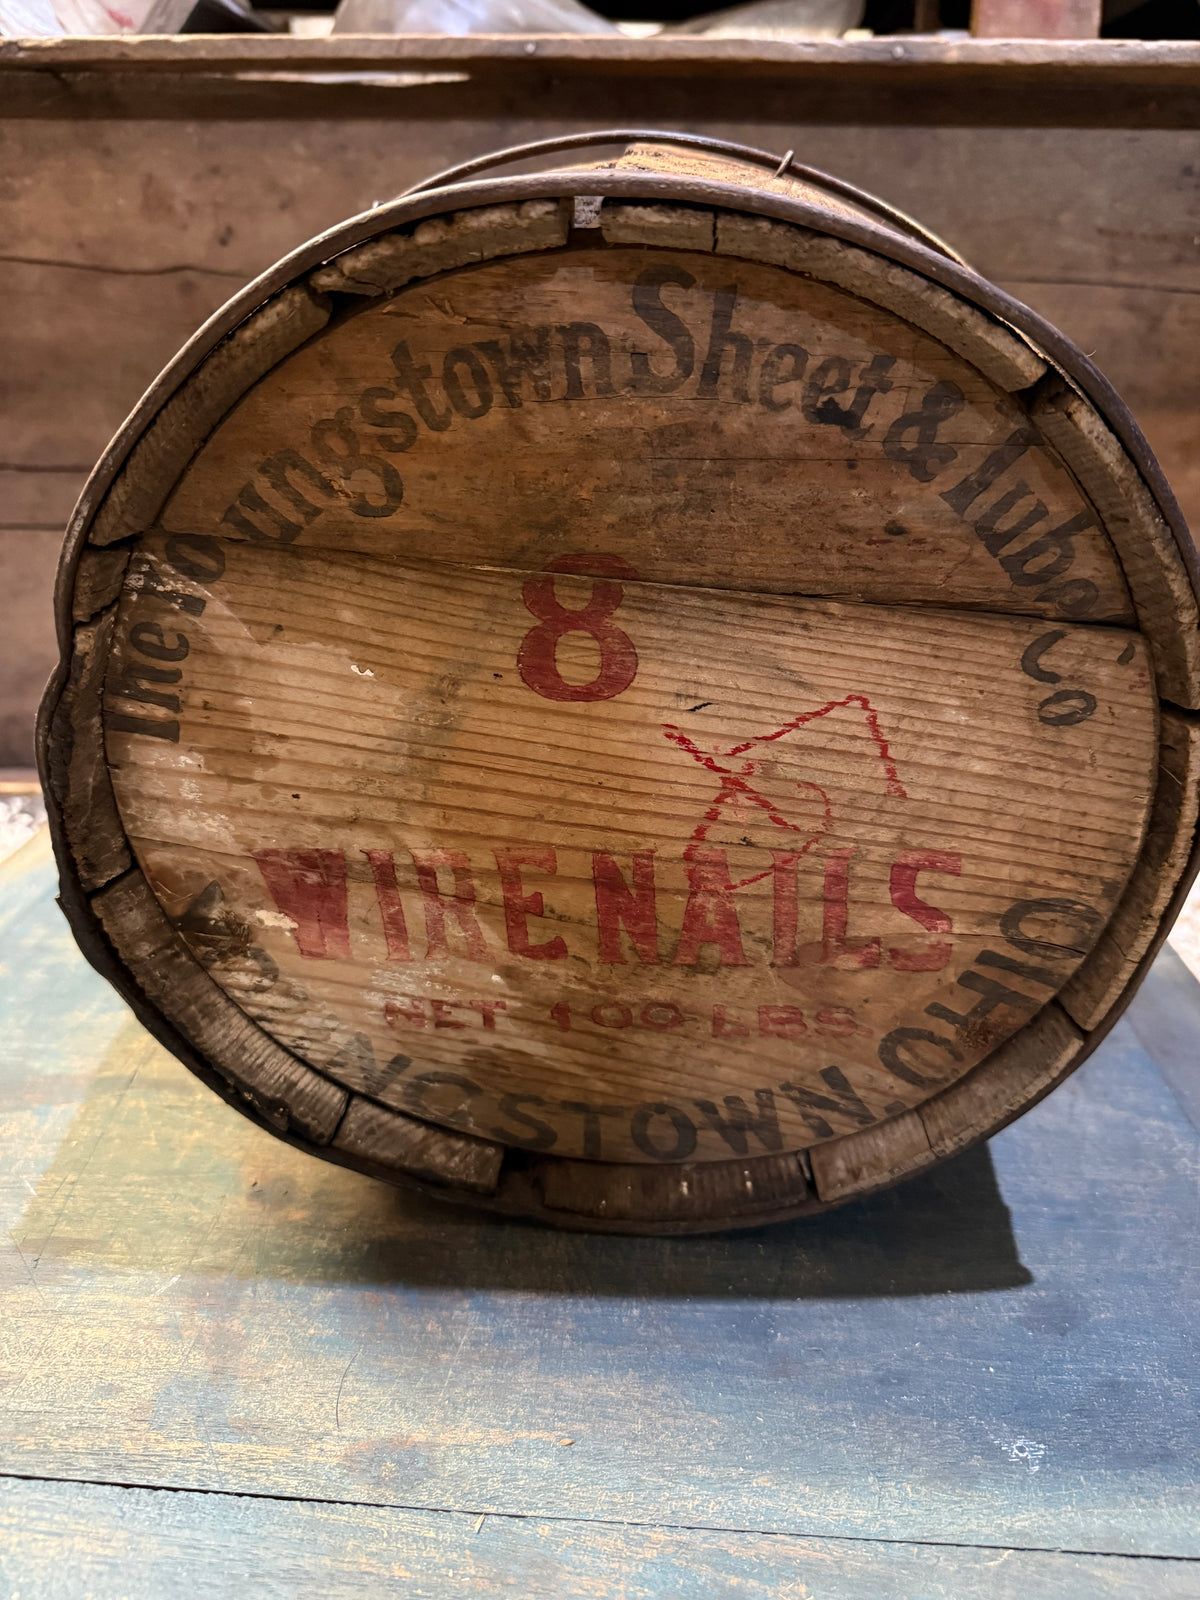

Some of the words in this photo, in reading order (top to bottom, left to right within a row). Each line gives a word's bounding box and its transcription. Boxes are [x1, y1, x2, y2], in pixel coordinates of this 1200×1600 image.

[628, 263, 897, 441] Sheet
[883, 380, 966, 483] &
[516, 553, 638, 702] 8
[253, 847, 568, 962] WIRE
[592, 847, 962, 973] NAILS
[551, 1001, 690, 1033] 100
[879, 897, 1105, 1090] OHIO
